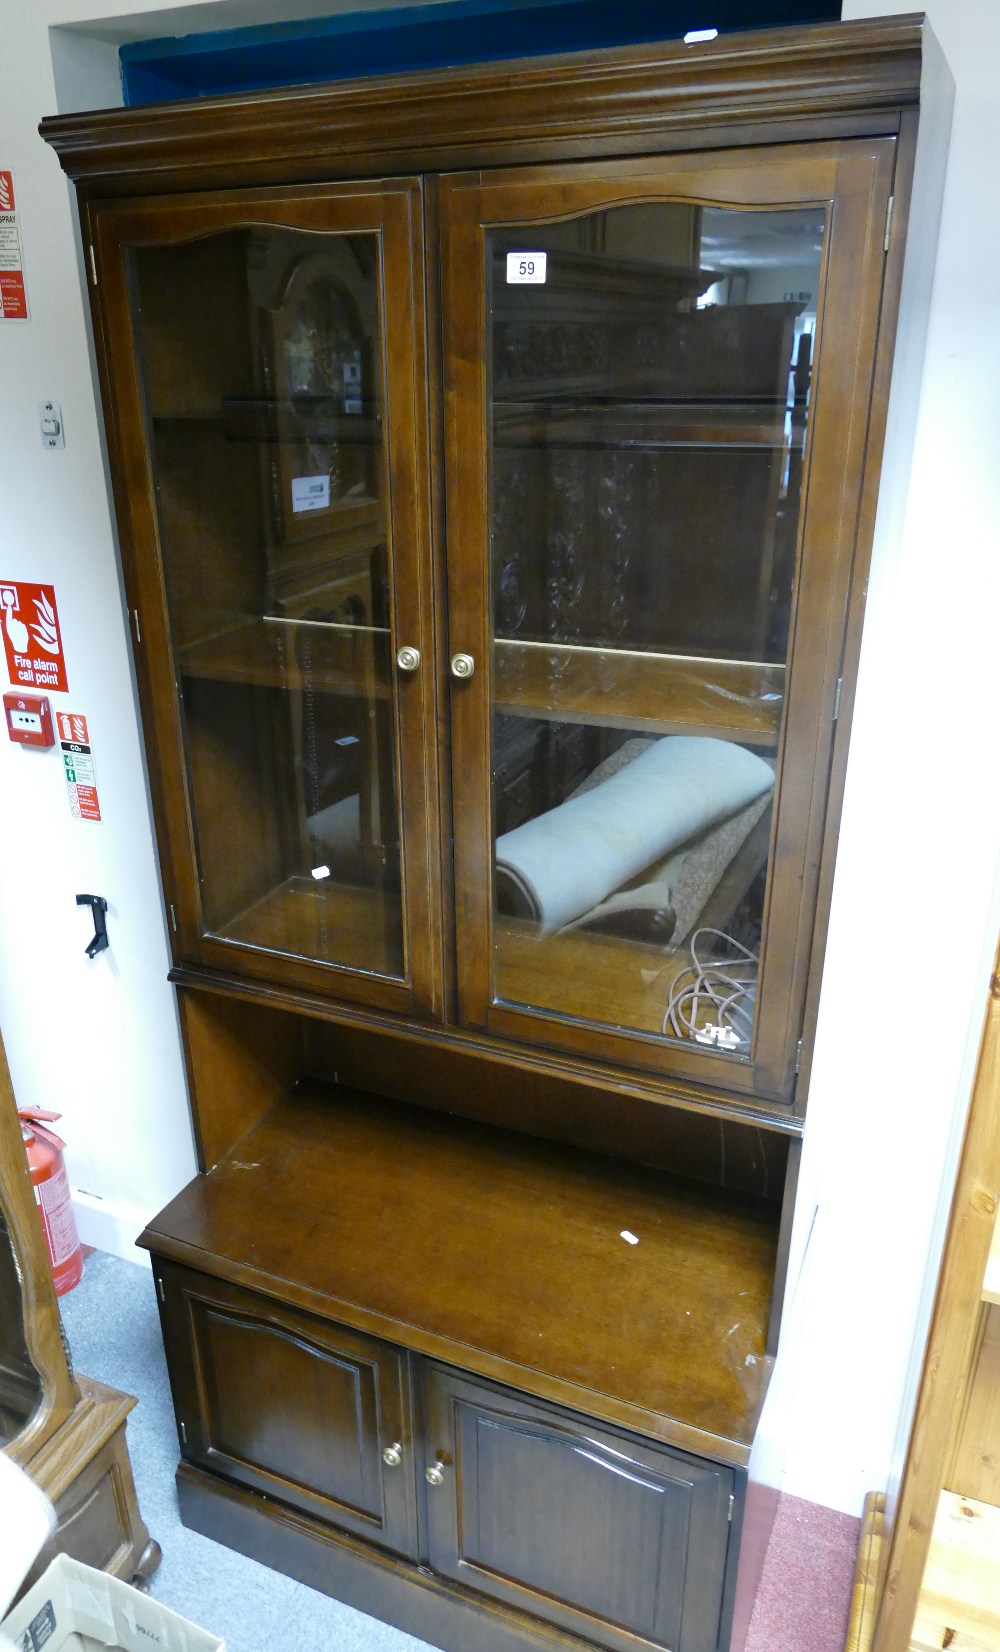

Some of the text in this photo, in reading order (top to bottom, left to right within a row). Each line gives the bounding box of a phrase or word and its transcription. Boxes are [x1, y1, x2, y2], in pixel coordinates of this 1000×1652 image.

[519, 261, 535, 275] 59
[14, 655, 58, 672] Fire alarm
[18, 670, 59, 686] call point
